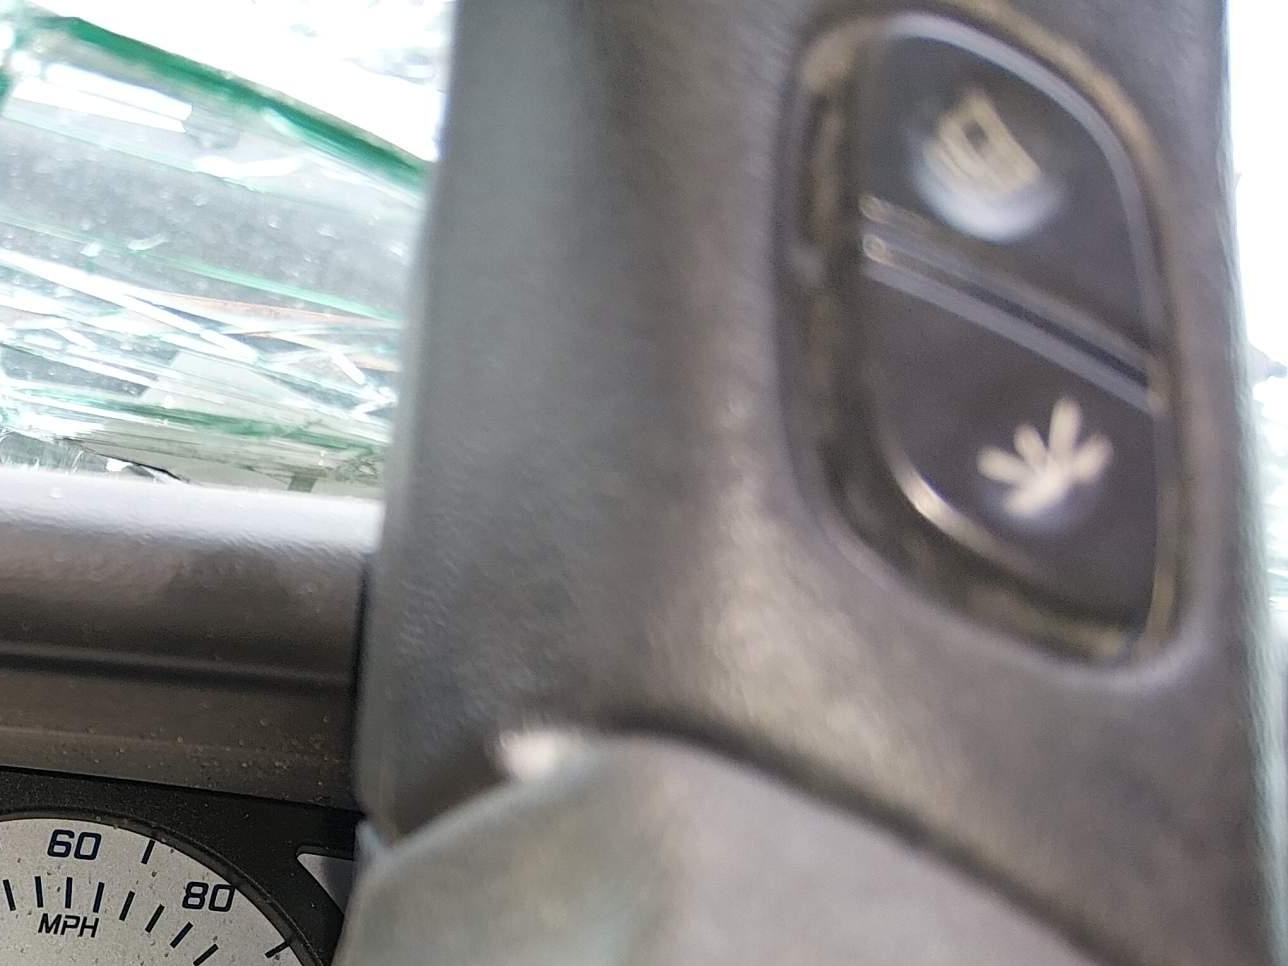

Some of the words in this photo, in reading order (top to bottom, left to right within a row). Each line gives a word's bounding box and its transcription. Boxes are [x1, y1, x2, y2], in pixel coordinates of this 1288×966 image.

[48, 830, 101, 860] 60
[182, 881, 235, 912] 80
[38, 913, 99, 938] MPH
